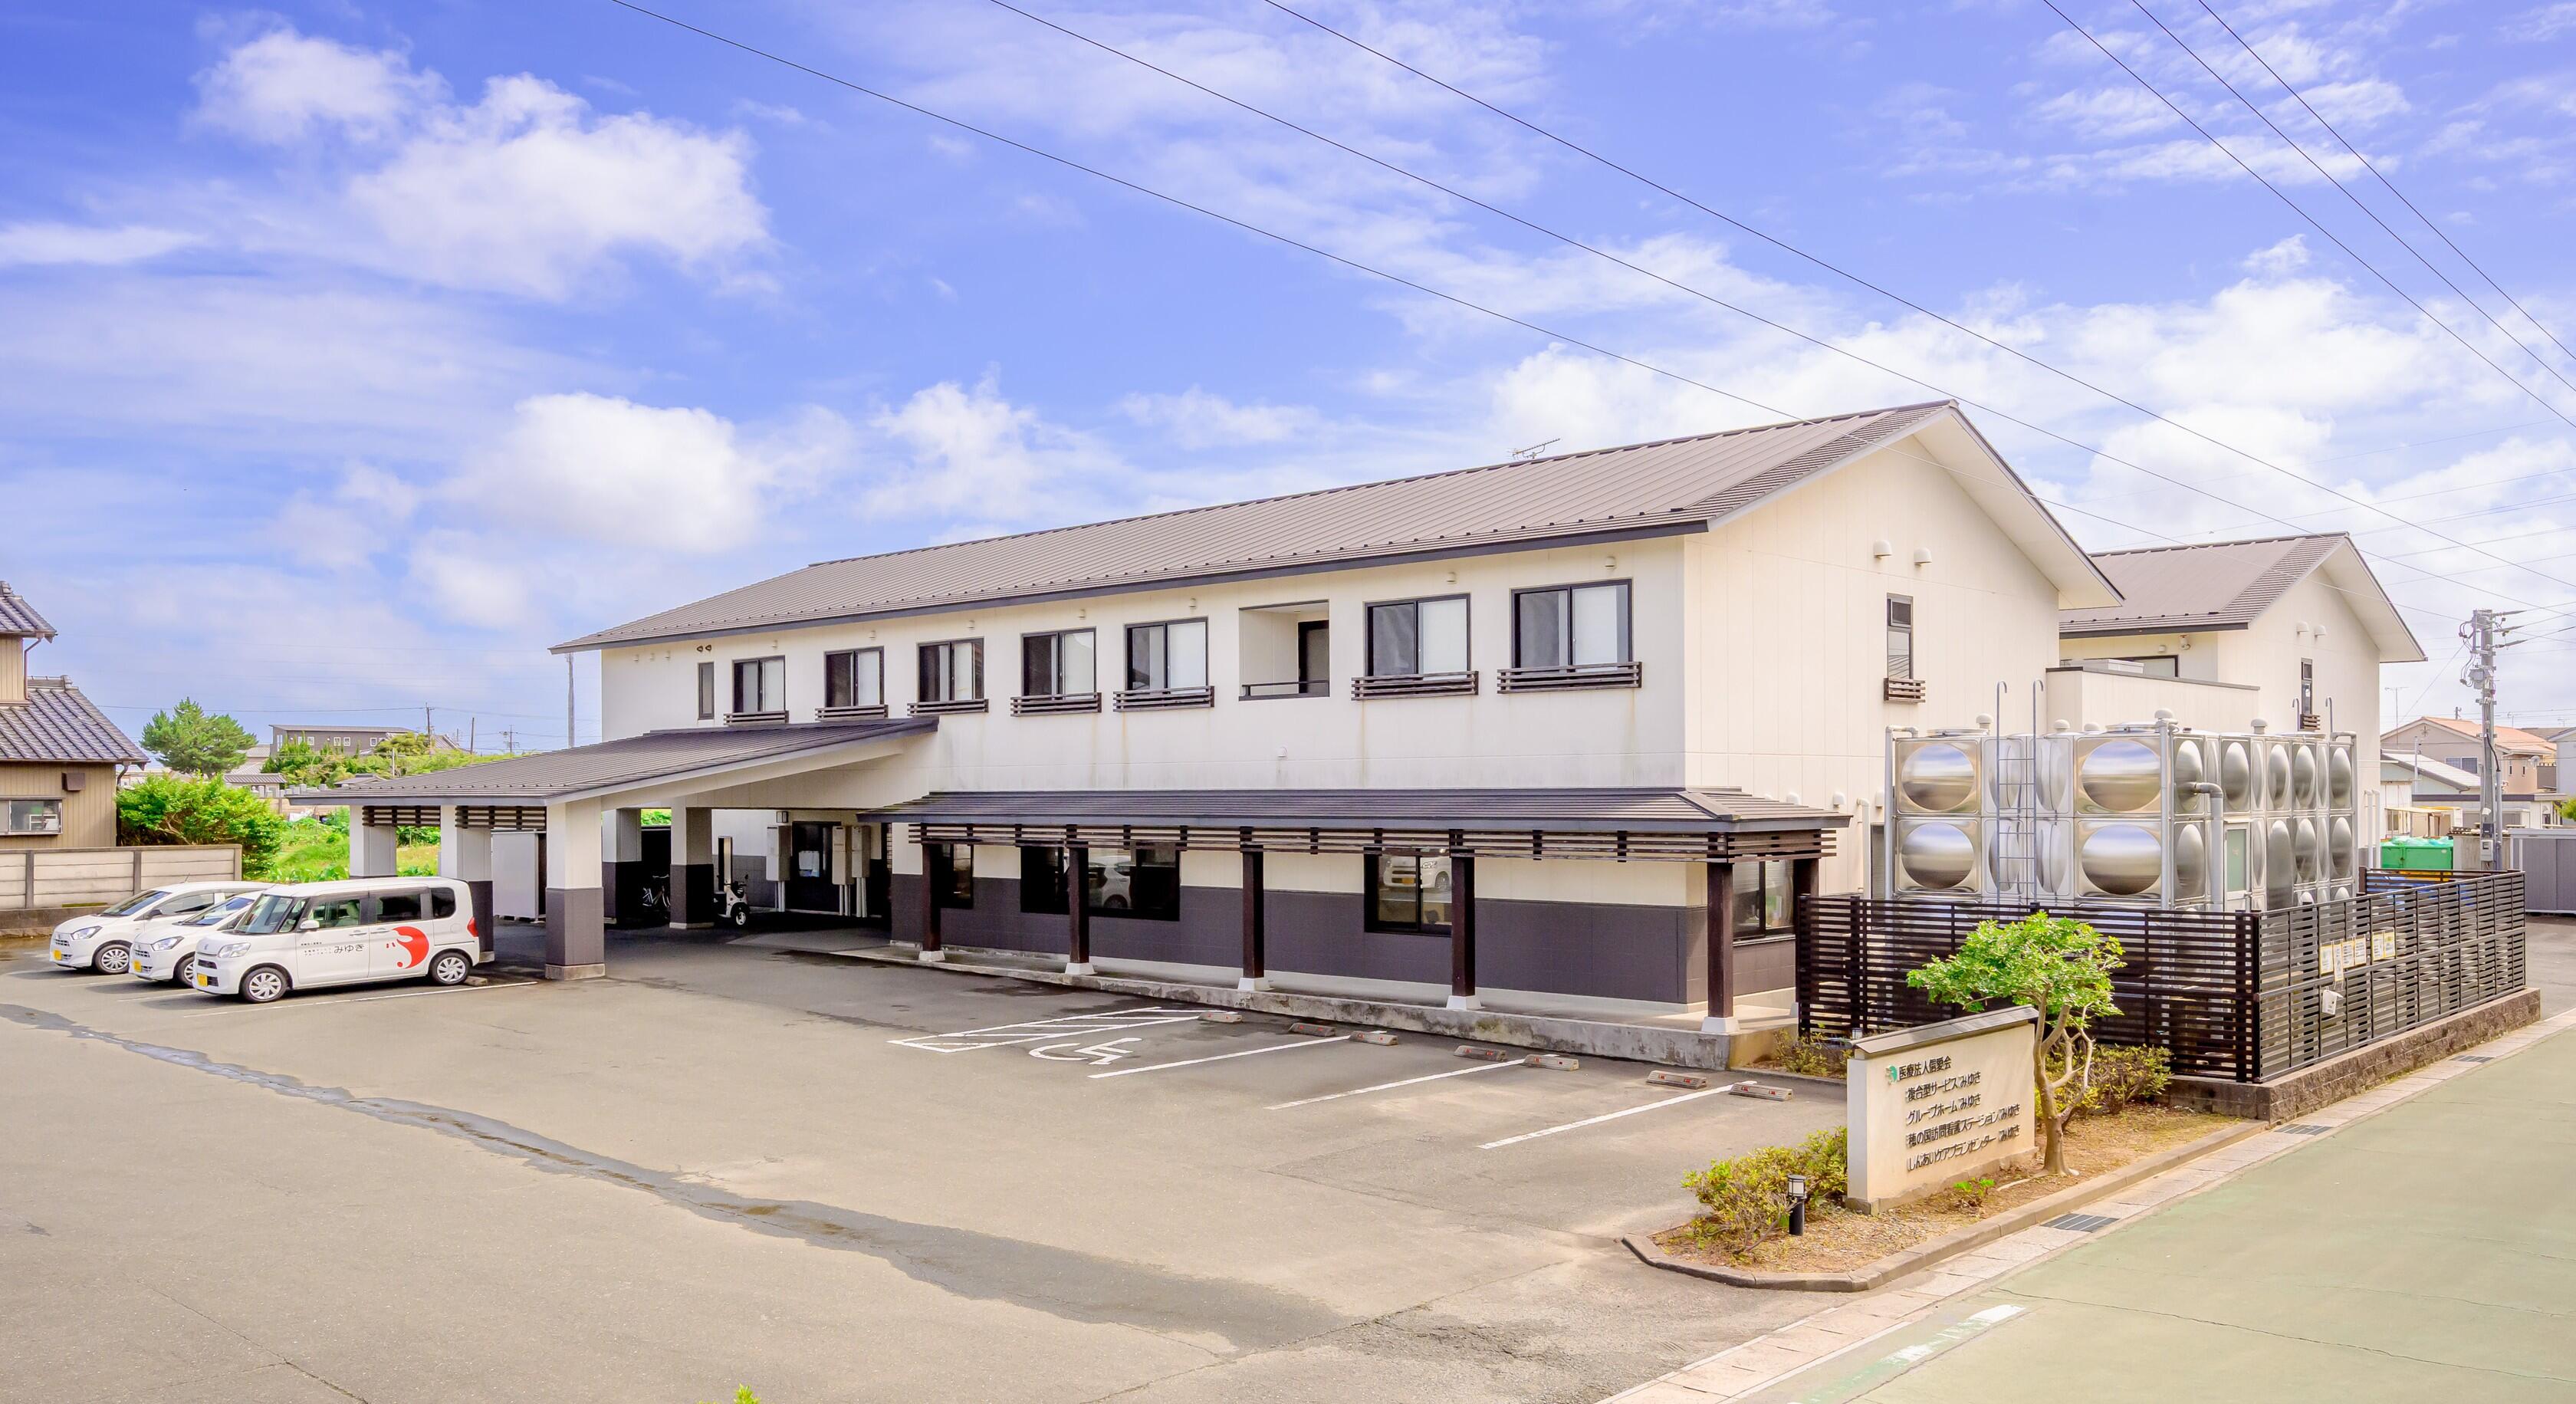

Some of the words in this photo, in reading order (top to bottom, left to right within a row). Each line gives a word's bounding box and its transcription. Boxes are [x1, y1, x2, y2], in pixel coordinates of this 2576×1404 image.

[334, 944, 364, 954] みゆき
[1899, 1056, 1951, 1080] 医療法人信愛会
[1907, 1077, 1958, 1102] 複合型サービス
[1958, 1070, 1981, 1087] みゆき
[1907, 1100, 1957, 1126] グループホーム
[1958, 1093, 1981, 1110] みゆき
[1907, 1111, 1998, 1147] 穂の国訪問看護ステーション
[1999, 1103, 2020, 1120] みゆき
[1907, 1135, 1996, 1171] しんあいケアプランセンター
[1999, 1124, 2020, 1142] みゆき
